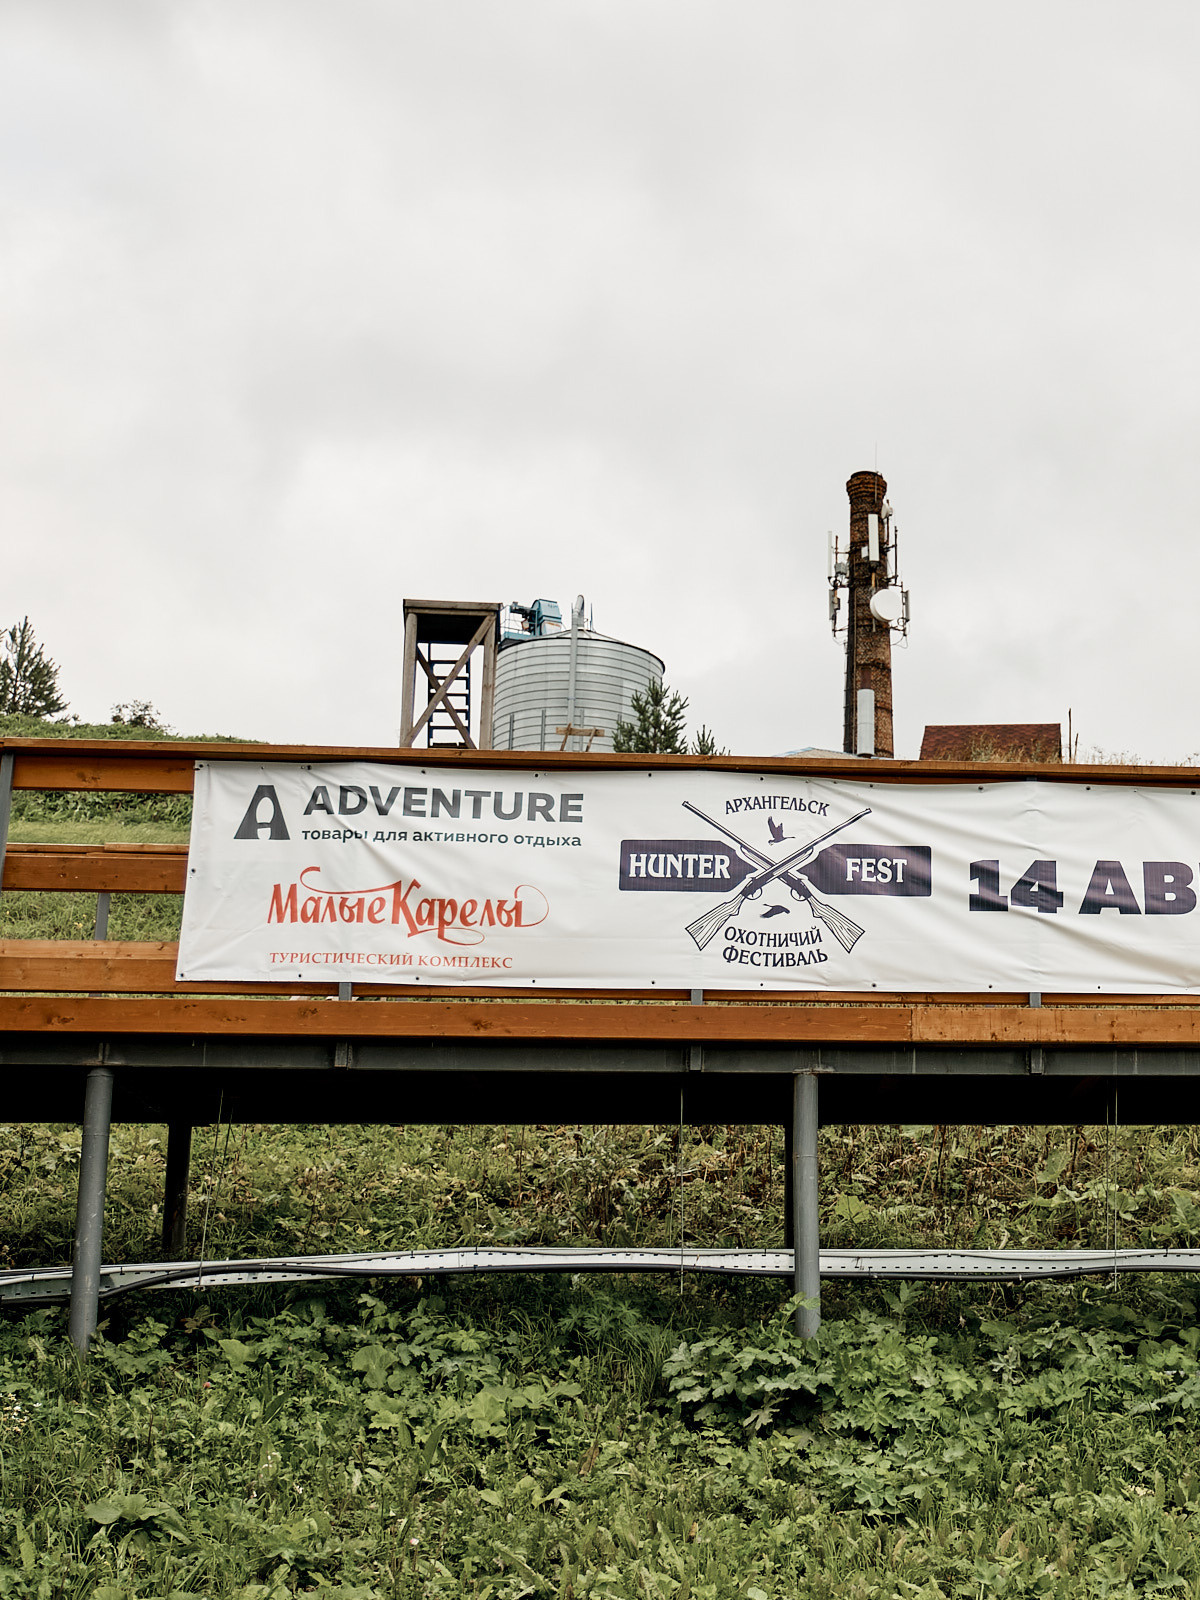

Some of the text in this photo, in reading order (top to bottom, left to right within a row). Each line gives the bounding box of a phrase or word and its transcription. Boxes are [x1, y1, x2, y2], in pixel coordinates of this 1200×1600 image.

[303, 785, 585, 823] ADVENTURE
[724, 795, 830, 817] АРХАНГЕЛЬСК
[301, 828, 582, 848] товары для активного отдыха
[629, 853, 908, 884] HUNTER FEST
[969, 860, 1064, 914] 14
[724, 926, 823, 948] ОХОТНИЧИЙ
[269, 951, 513, 969] ТУРИСТИЧЕСКИЙ КОМПЛЕКС
[722, 945, 829, 968] ФЕСТИВАЛЬ
